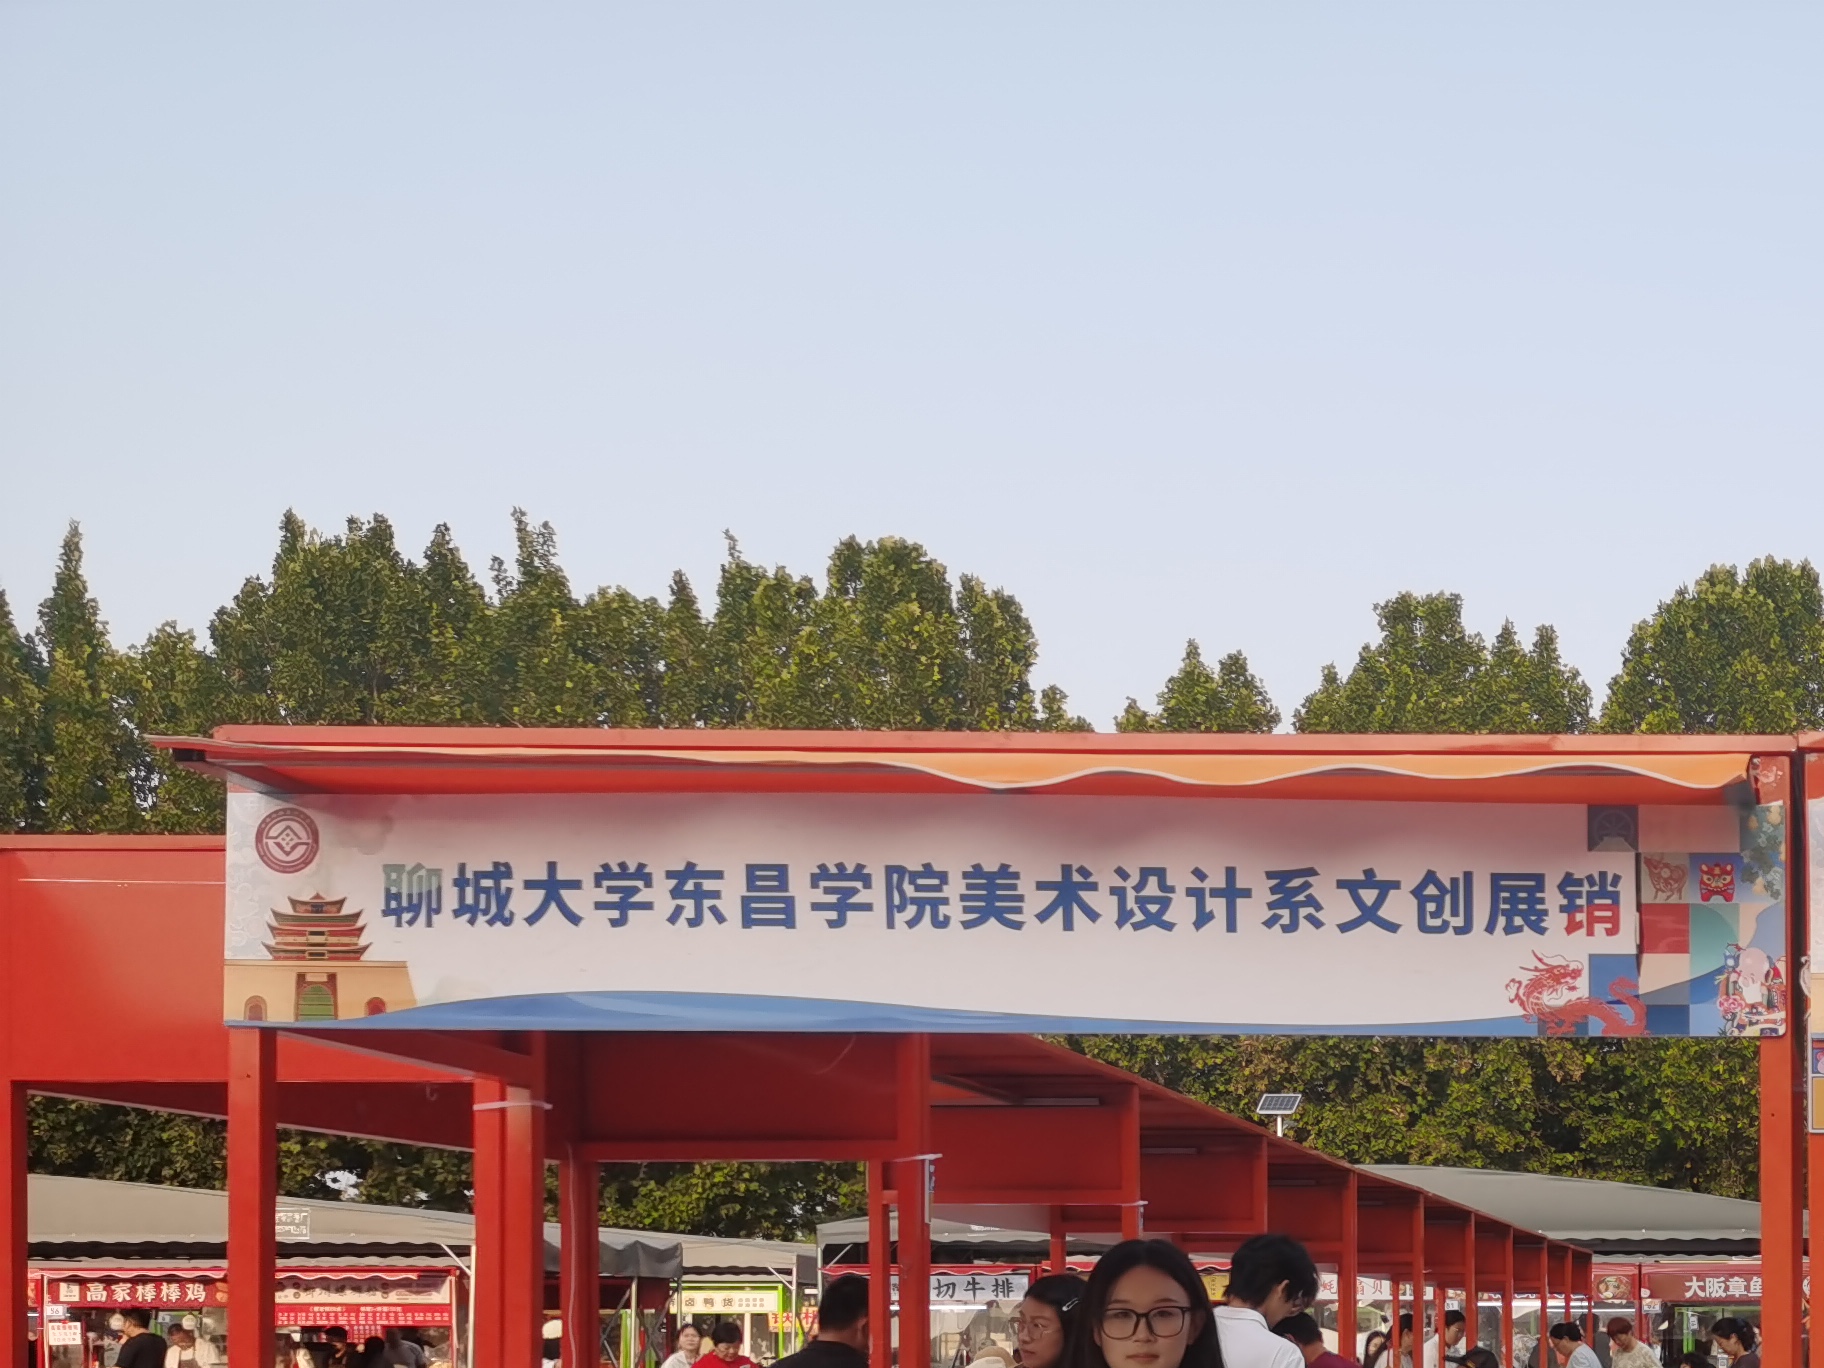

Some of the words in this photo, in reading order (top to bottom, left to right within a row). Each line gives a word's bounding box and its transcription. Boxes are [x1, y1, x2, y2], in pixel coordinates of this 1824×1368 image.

[380, 859, 1624, 936] 聊城大学东昌学院美术设计系文创展销
[85, 1281, 207, 1303] 高家棒棒鸡
[50, 1307, 60, 1315] 56
